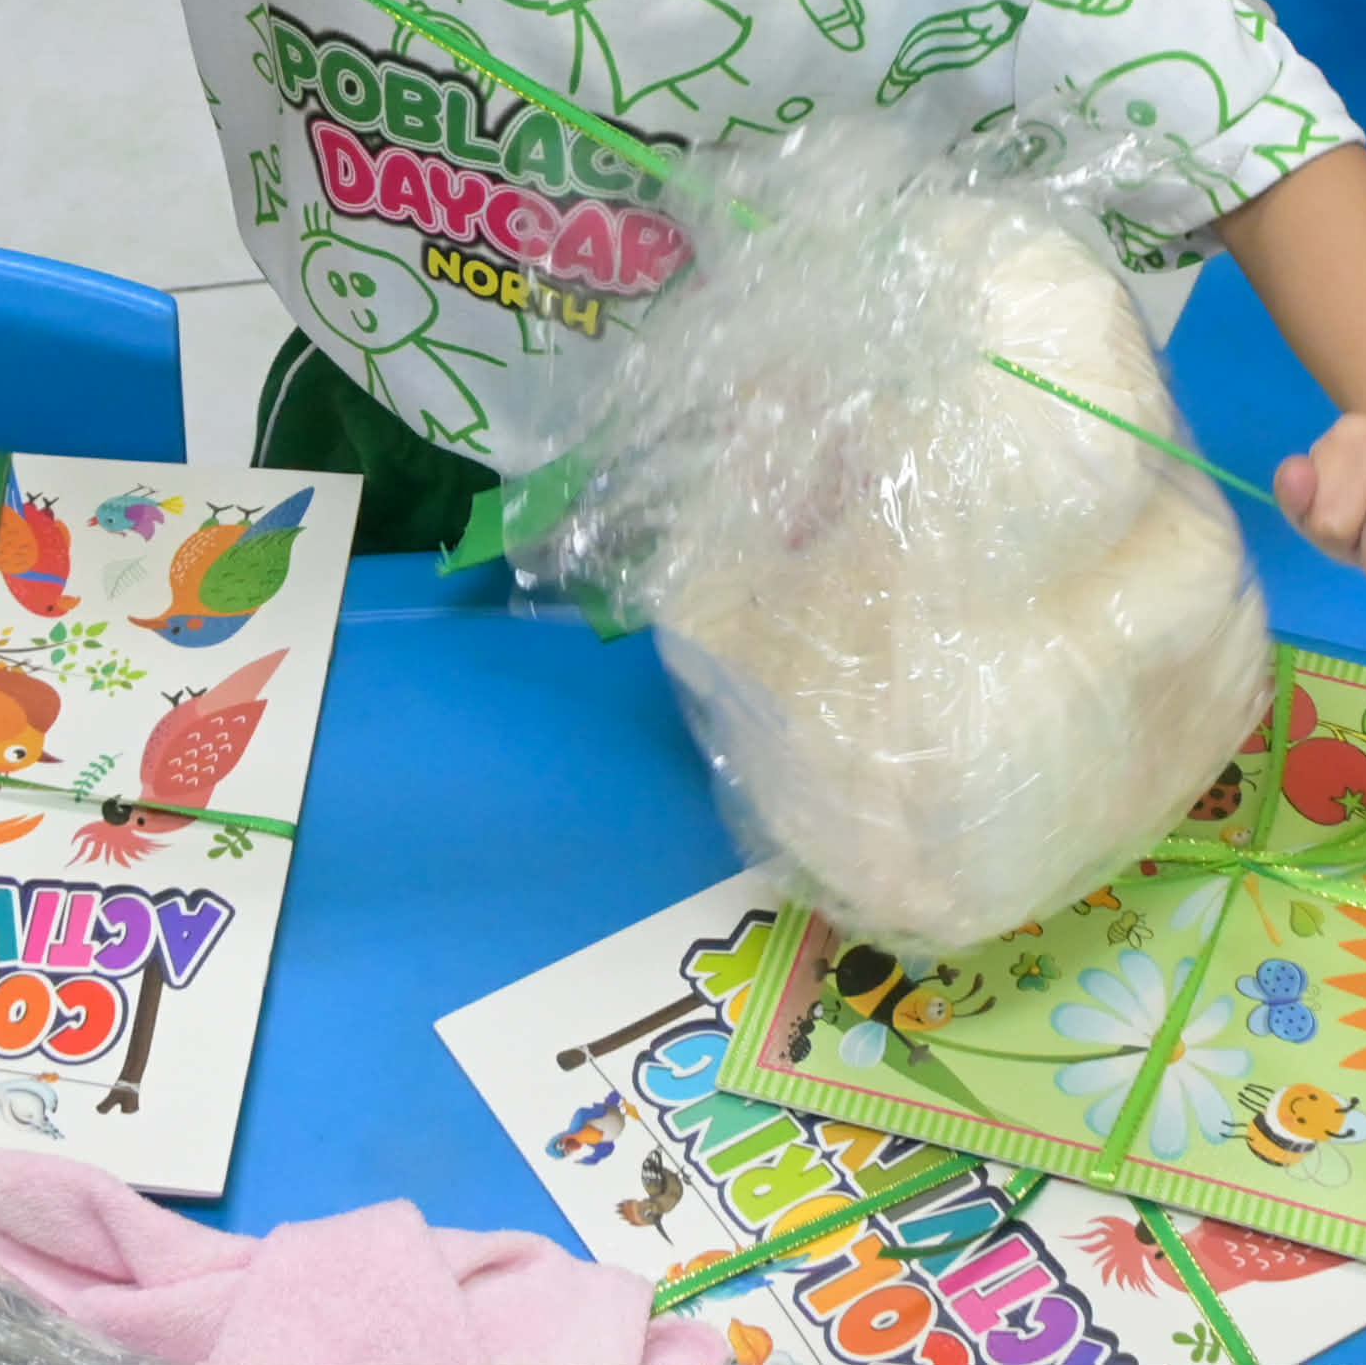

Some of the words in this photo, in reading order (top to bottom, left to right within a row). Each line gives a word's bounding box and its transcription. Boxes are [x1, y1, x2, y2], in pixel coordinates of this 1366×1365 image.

[267, 15, 685, 205] POBLAC
[311, 117, 697, 298] DAYCAR
[423, 243, 603, 337] NORTH
[814, 1119, 1127, 1365] CTIVITY
